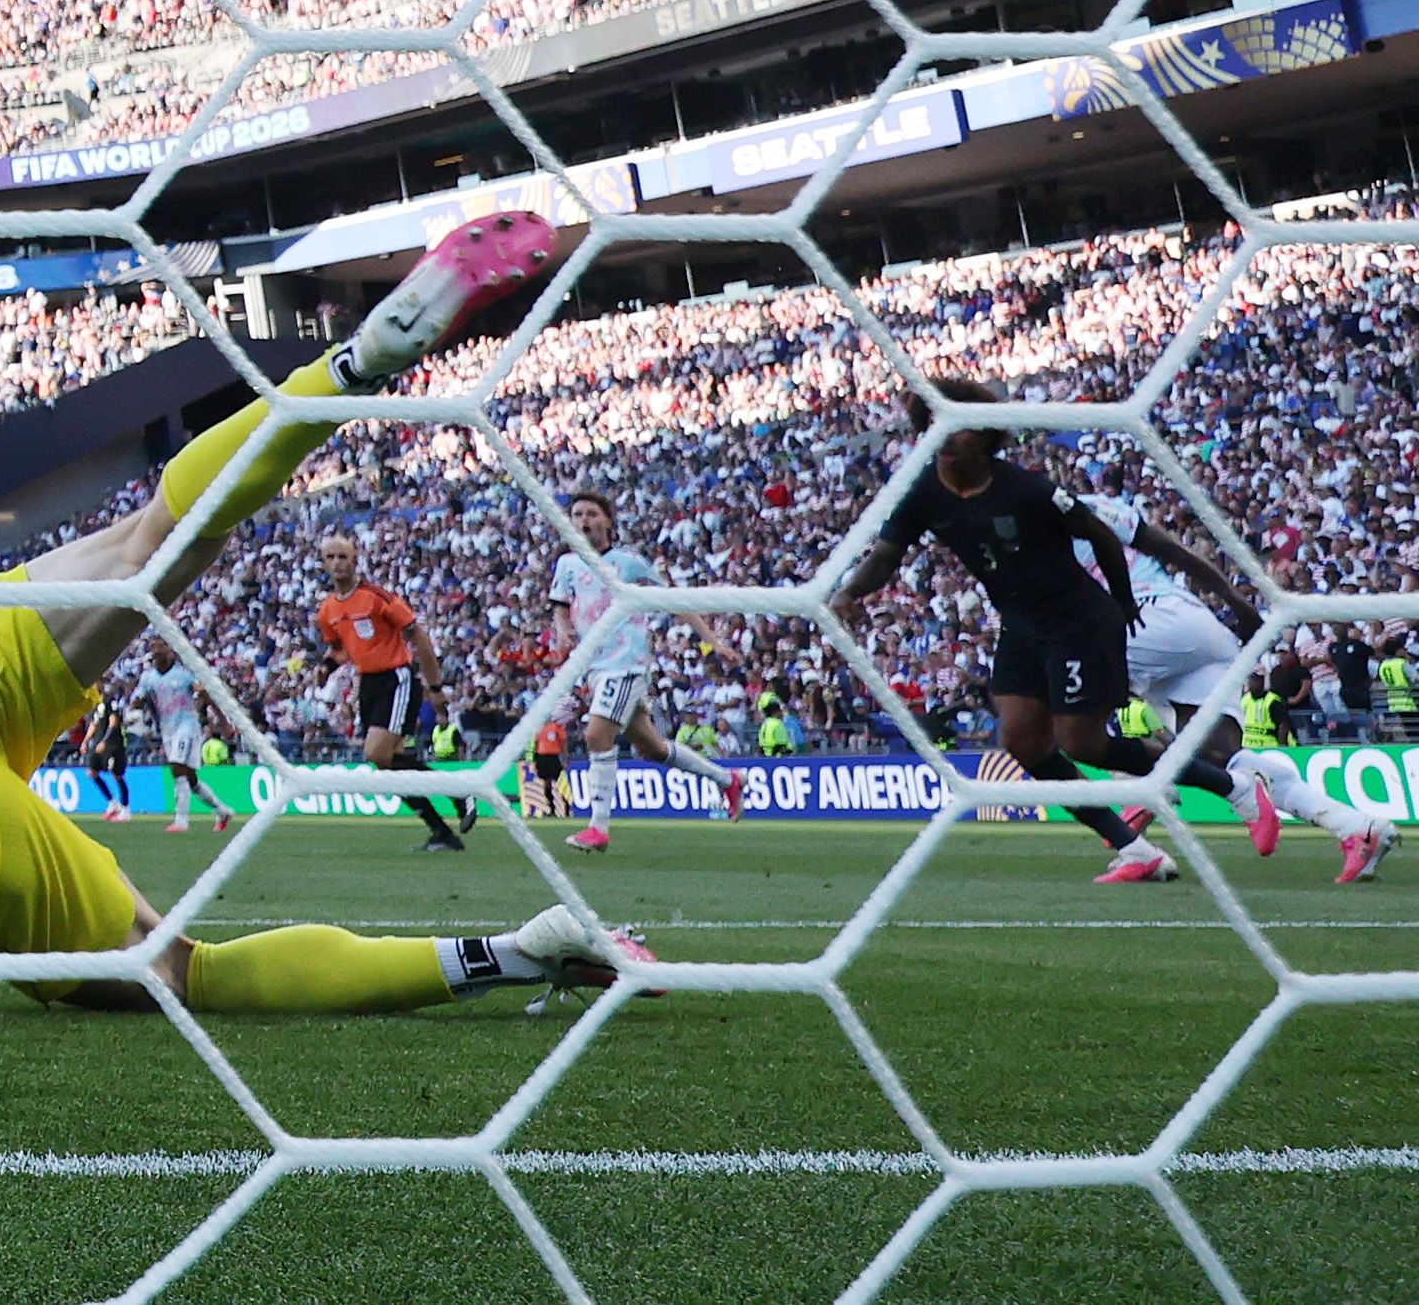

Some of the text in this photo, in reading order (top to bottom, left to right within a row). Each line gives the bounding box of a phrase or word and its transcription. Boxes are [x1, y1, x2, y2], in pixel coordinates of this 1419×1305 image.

[11, 154, 80, 184] FIFA
[231, 105, 312, 148] 2026
[1065, 659, 1084, 694] 3
[569, 768, 665, 810] UTED
[772, 765, 812, 810] OF
